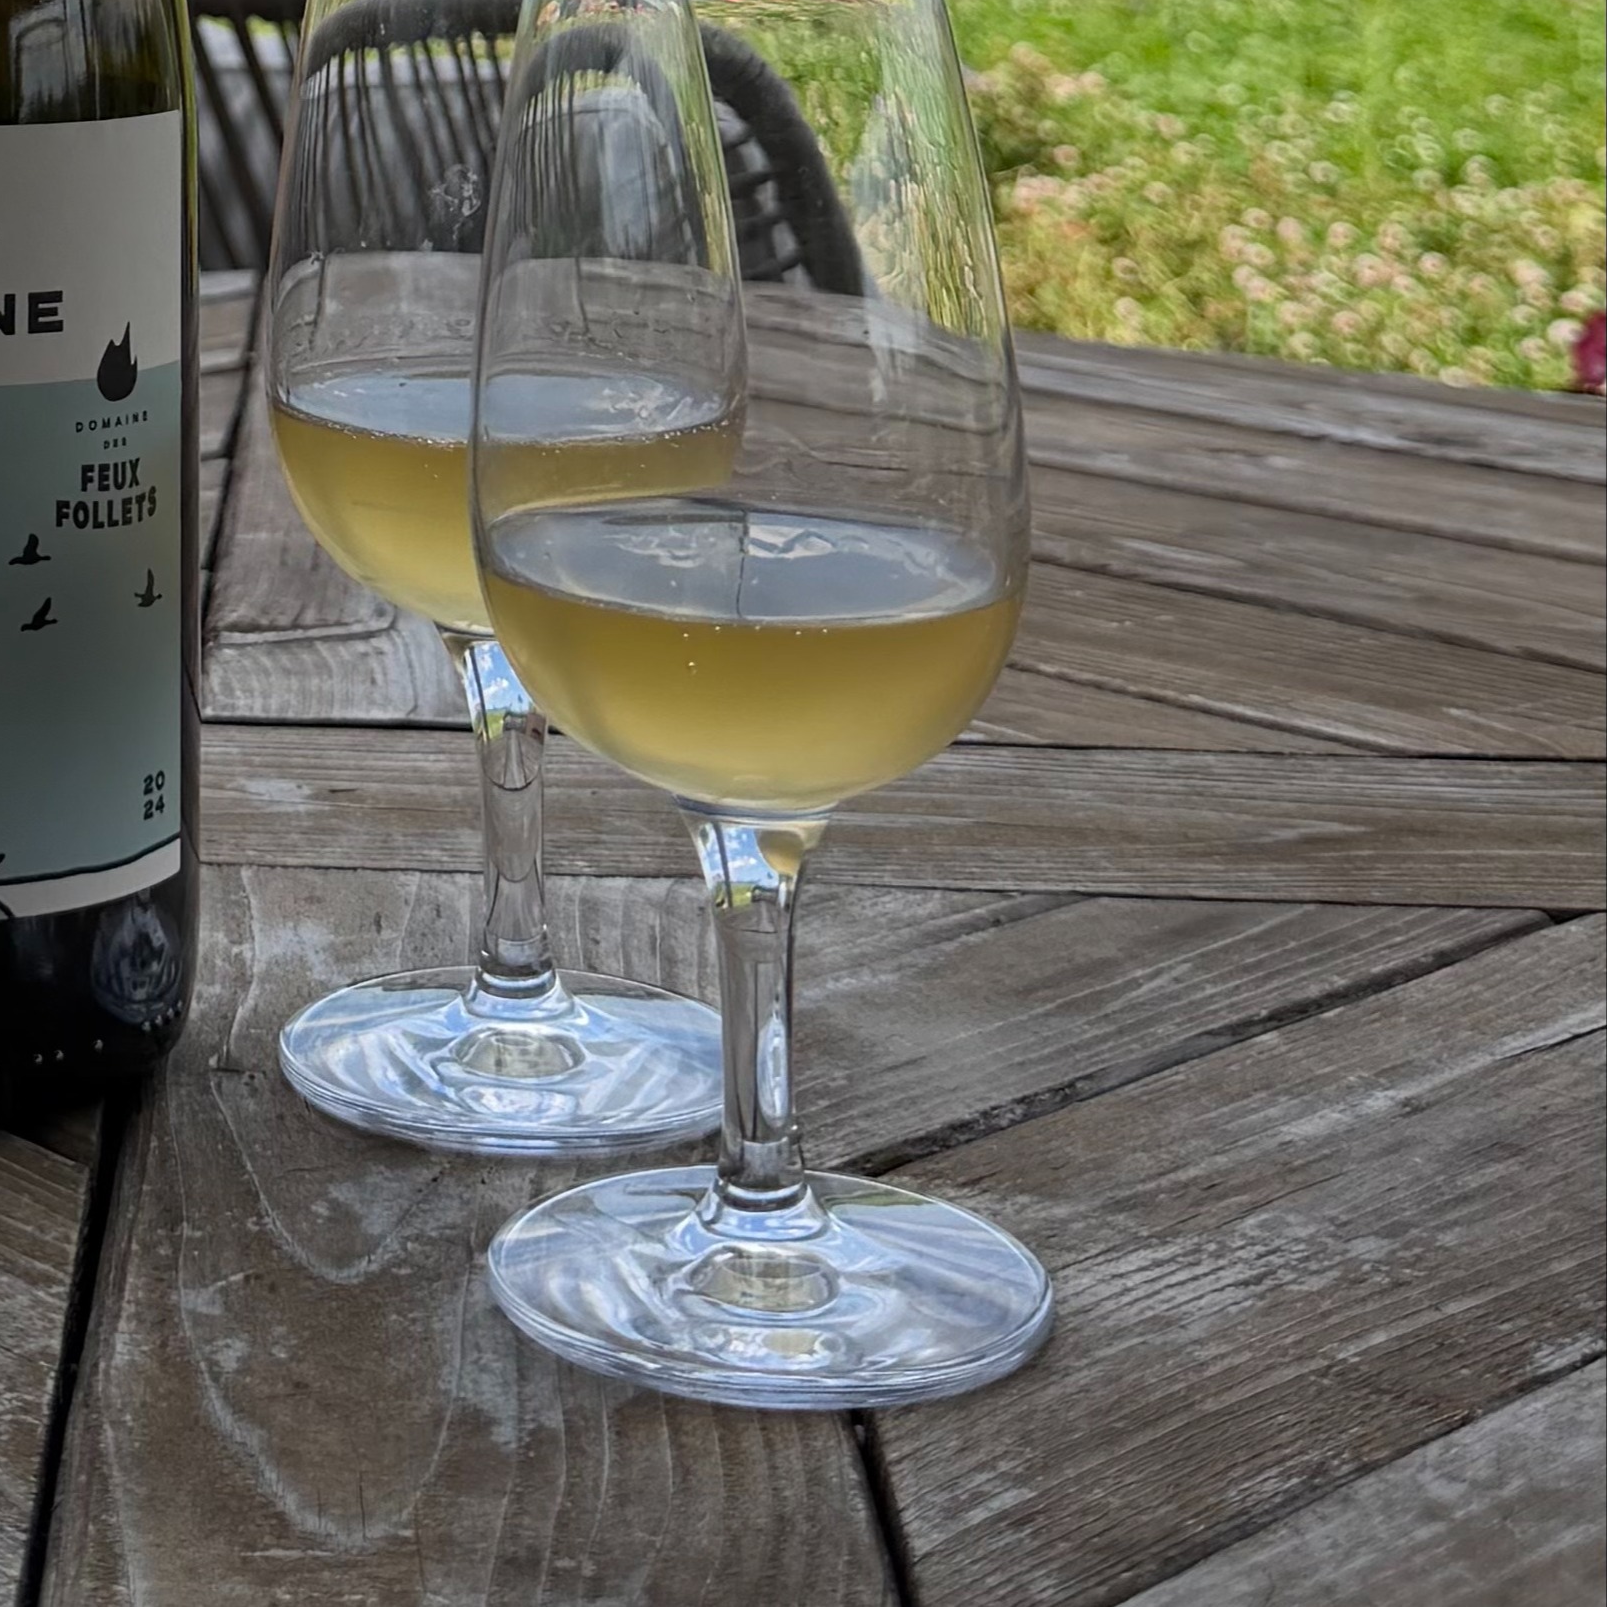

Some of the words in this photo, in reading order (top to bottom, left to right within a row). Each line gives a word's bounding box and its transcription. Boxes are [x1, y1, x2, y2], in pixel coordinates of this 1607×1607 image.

[75, 410, 148, 433] DOMAINE
[103, 437, 127, 450] DES
[80, 457, 141, 492] FEUX
[55, 485, 158, 529] FOLLETS
[143, 770, 165, 796] 20
[143, 793, 165, 821] 24
